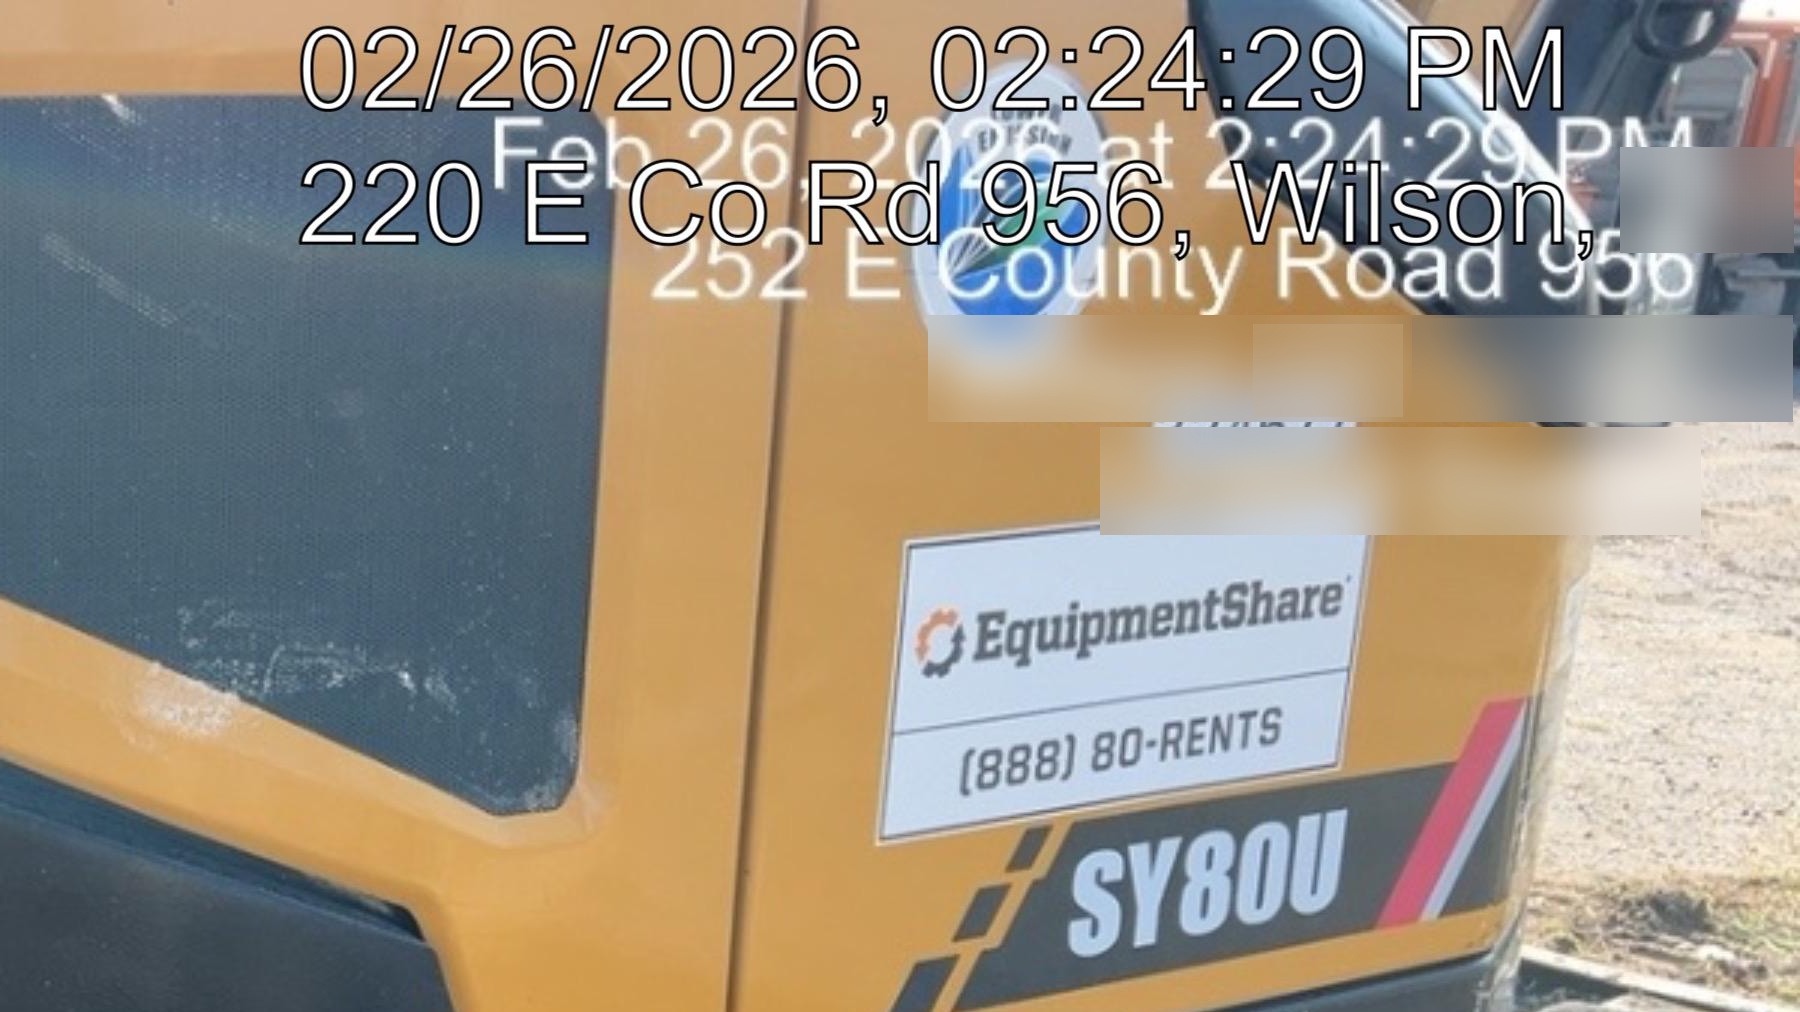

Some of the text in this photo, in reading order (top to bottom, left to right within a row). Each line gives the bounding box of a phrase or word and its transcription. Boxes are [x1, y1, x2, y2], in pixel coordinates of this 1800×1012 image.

[972, 581, 1343, 667] EquipmentShare
[959, 706, 1284, 796] (888) 80-RENTS
[1066, 808, 1349, 958] SY80U
